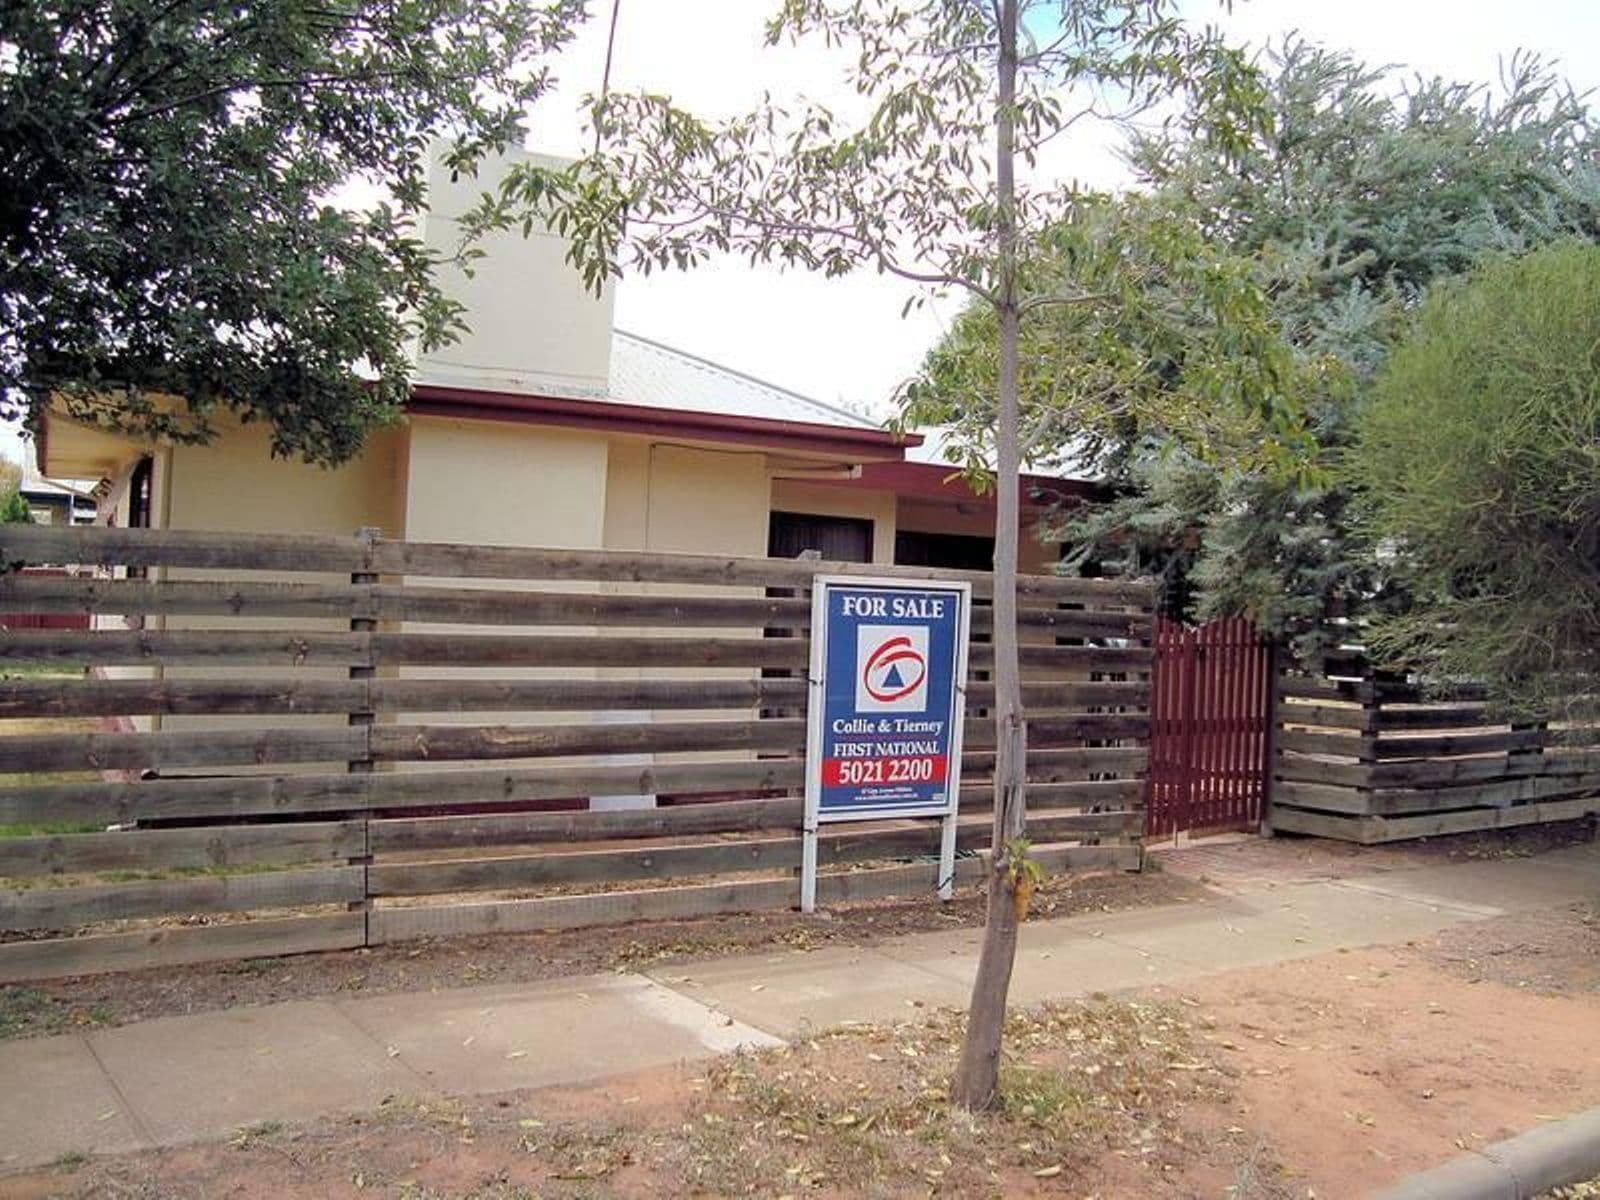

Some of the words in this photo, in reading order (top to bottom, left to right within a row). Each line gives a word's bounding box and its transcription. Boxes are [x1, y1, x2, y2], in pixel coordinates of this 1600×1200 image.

[842, 597, 888, 617] FOR
[892, 599, 944, 618] SALE
[833, 719, 875, 734] Collie
[877, 719, 892, 733] &
[894, 719, 944, 736] Tierney
[833, 742, 873, 757] FIRST
[875, 740, 940, 756] NATIONAL
[839, 760, 884, 785] 5021
[887, 758, 933, 781] 2200
